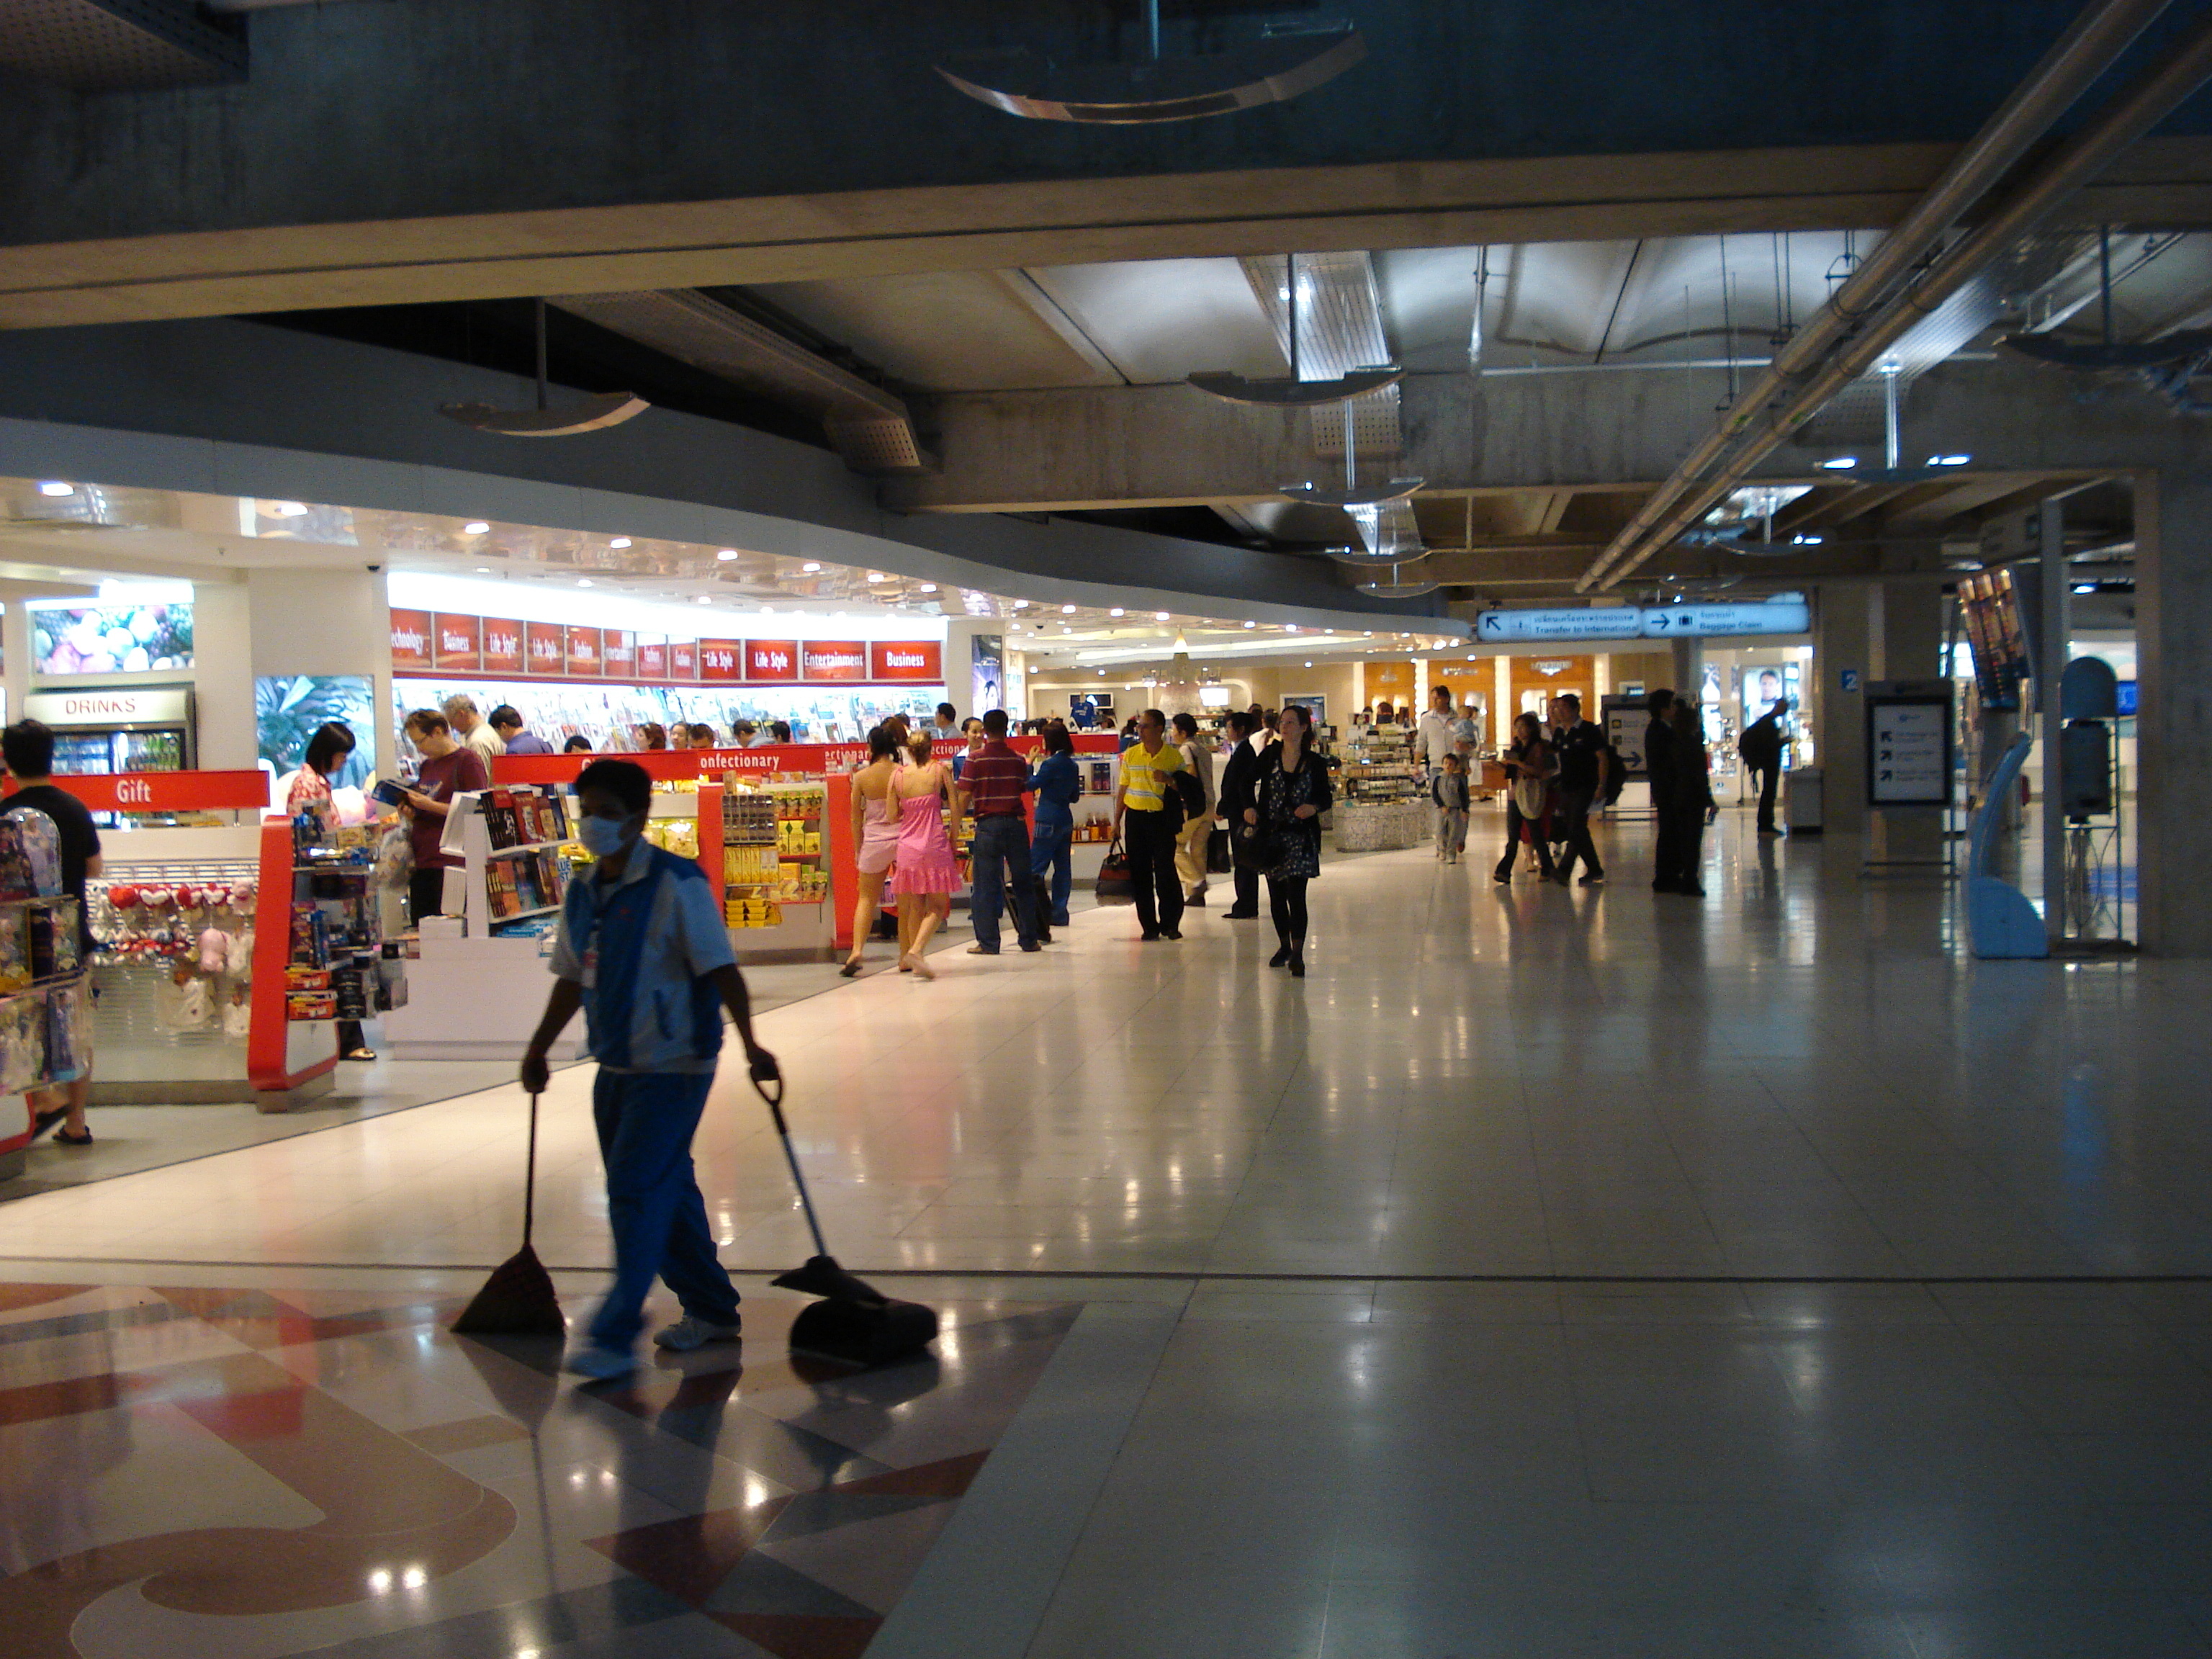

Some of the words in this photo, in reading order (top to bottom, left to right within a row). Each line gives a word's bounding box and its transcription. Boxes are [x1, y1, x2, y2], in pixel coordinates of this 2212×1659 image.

[1585, 624, 1640, 633] International
[707, 651, 718, 667] Life
[719, 651, 733, 672] Style
[755, 651, 768, 667] Life
[771, 651, 788, 672] Style
[804, 651, 863, 667] Entertainment
[886, 651, 924, 667] Business
[1847, 675, 1856, 689] 2
[66, 698, 135, 714] DRINKS
[700, 752, 780, 771] onfectionary
[117, 779, 152, 804] Gift
